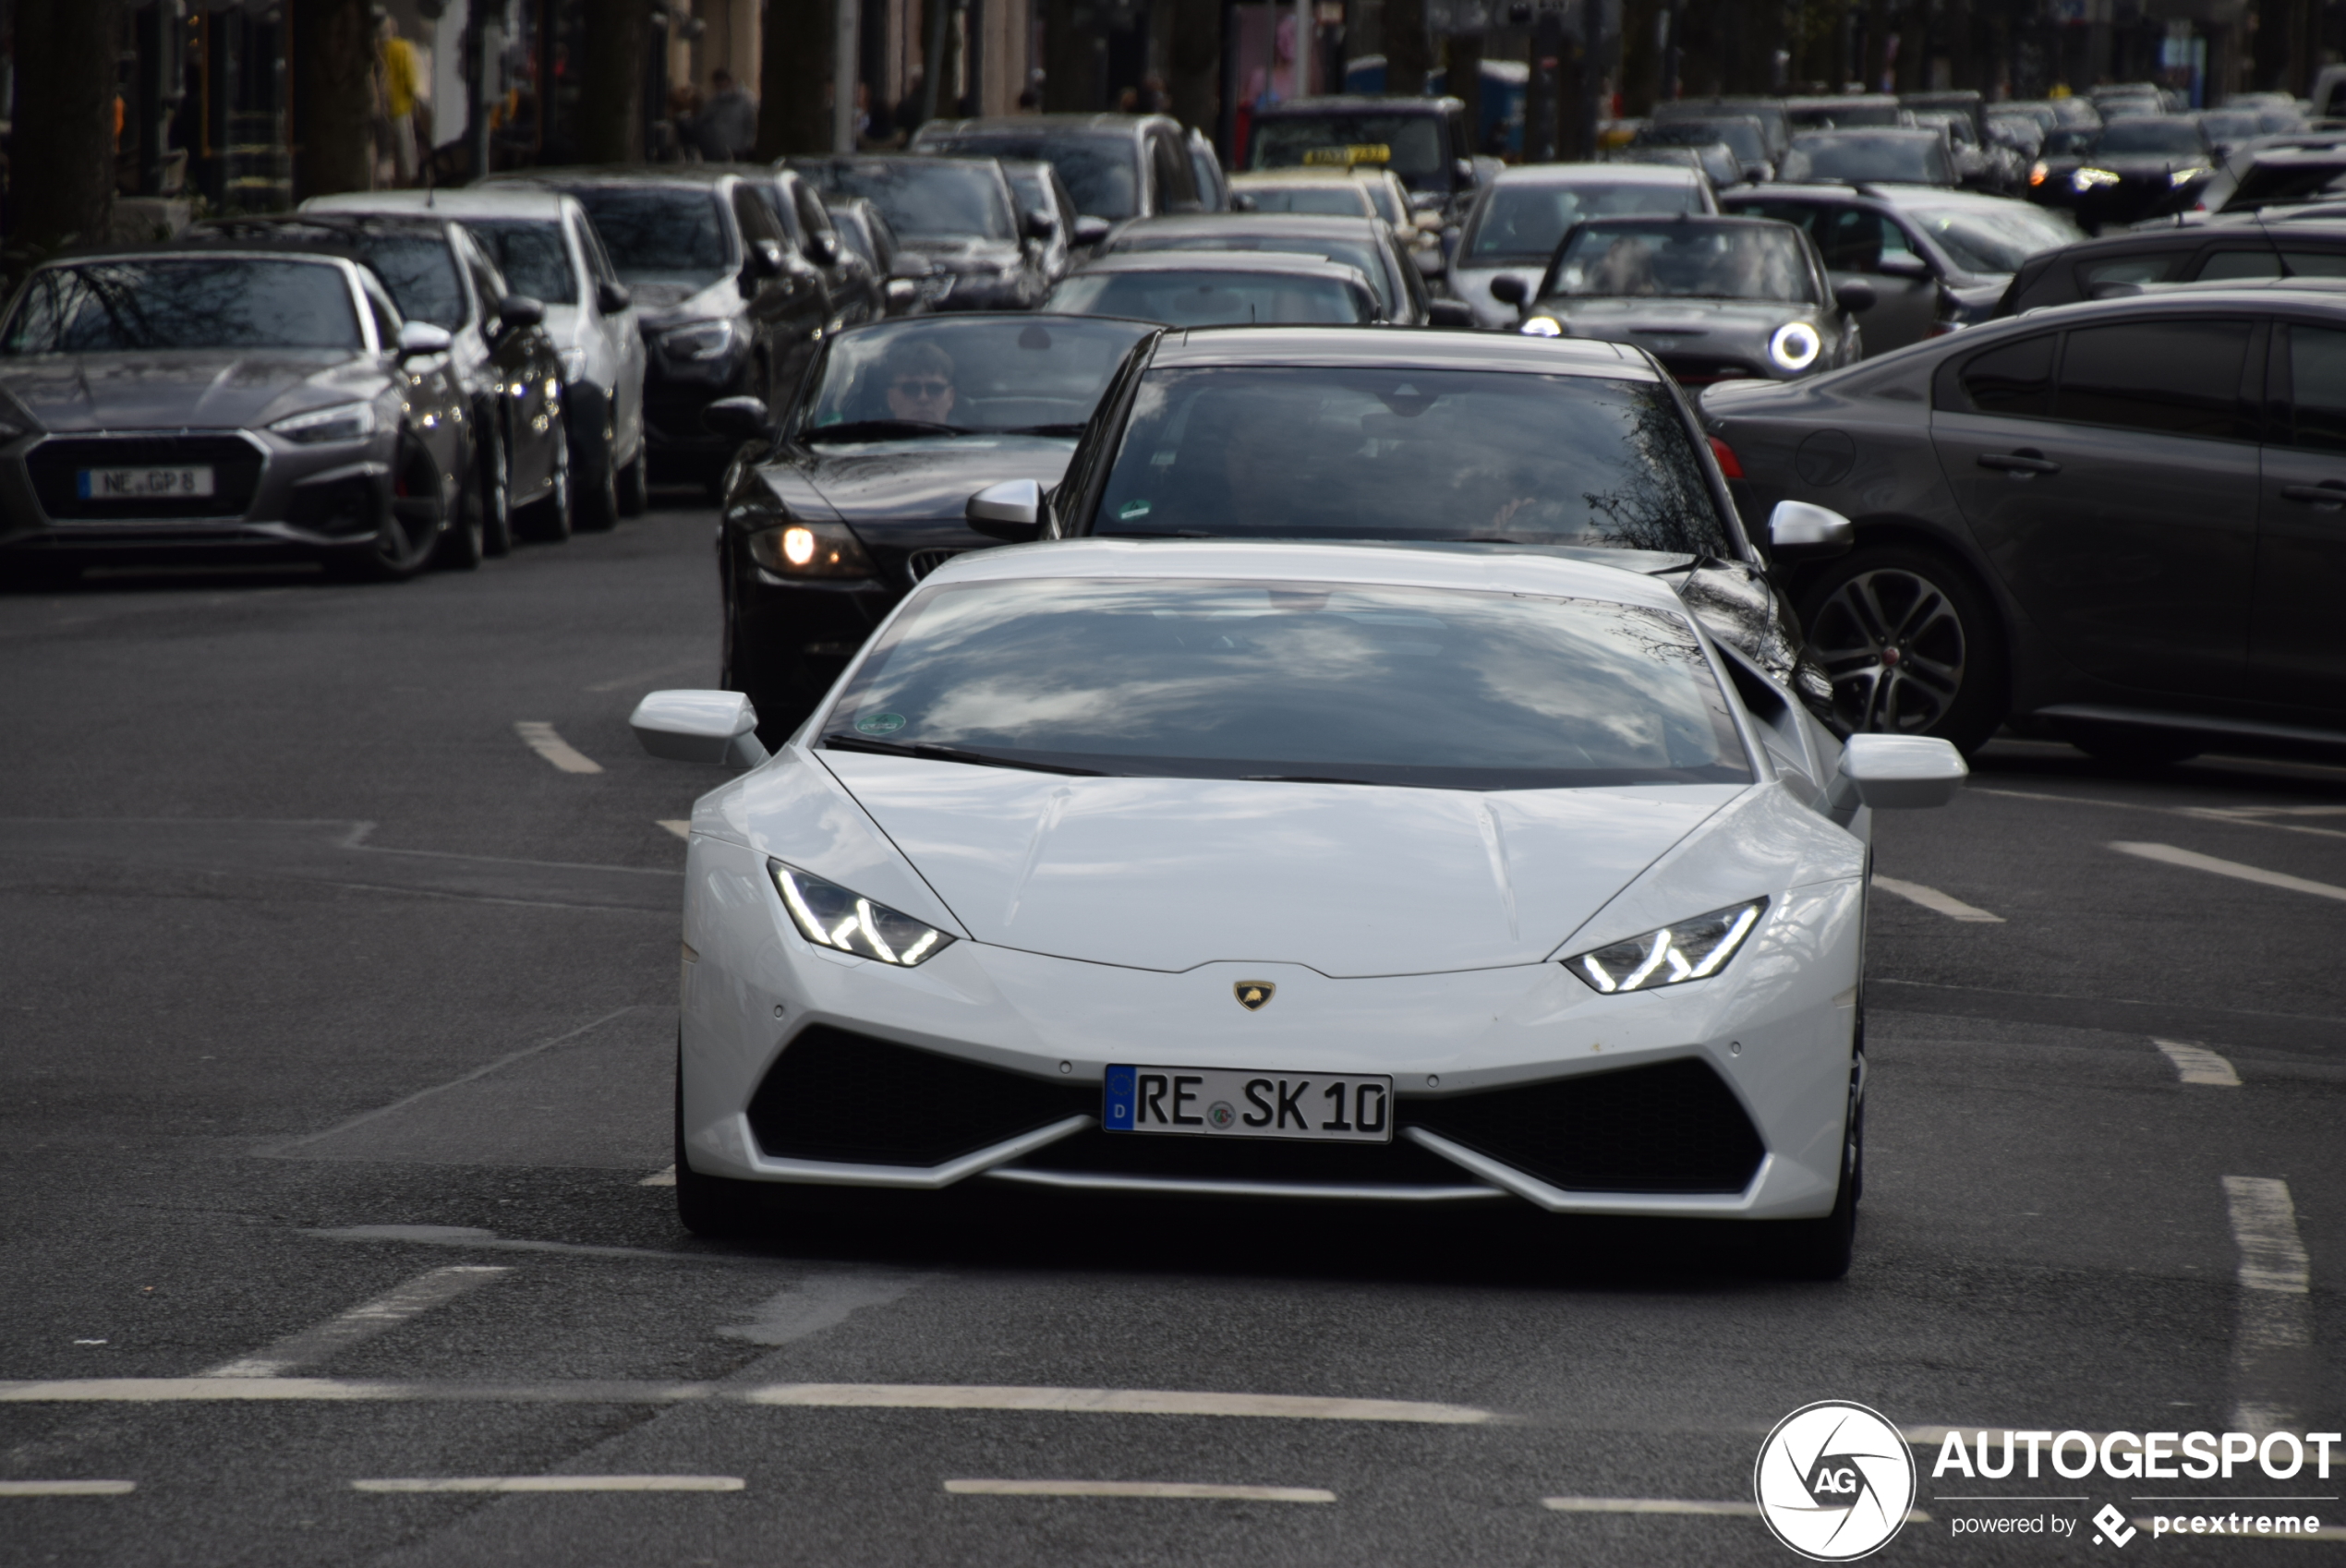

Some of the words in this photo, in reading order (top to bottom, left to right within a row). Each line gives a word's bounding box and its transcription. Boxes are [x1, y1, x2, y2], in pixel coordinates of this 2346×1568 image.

[104, 472, 131, 492] NE
[1114, 1104, 1125, 1118] D
[1137, 1074, 1203, 1125] RE
[1242, 1078, 1311, 1129] SK
[1322, 1081, 1385, 1133] 10
